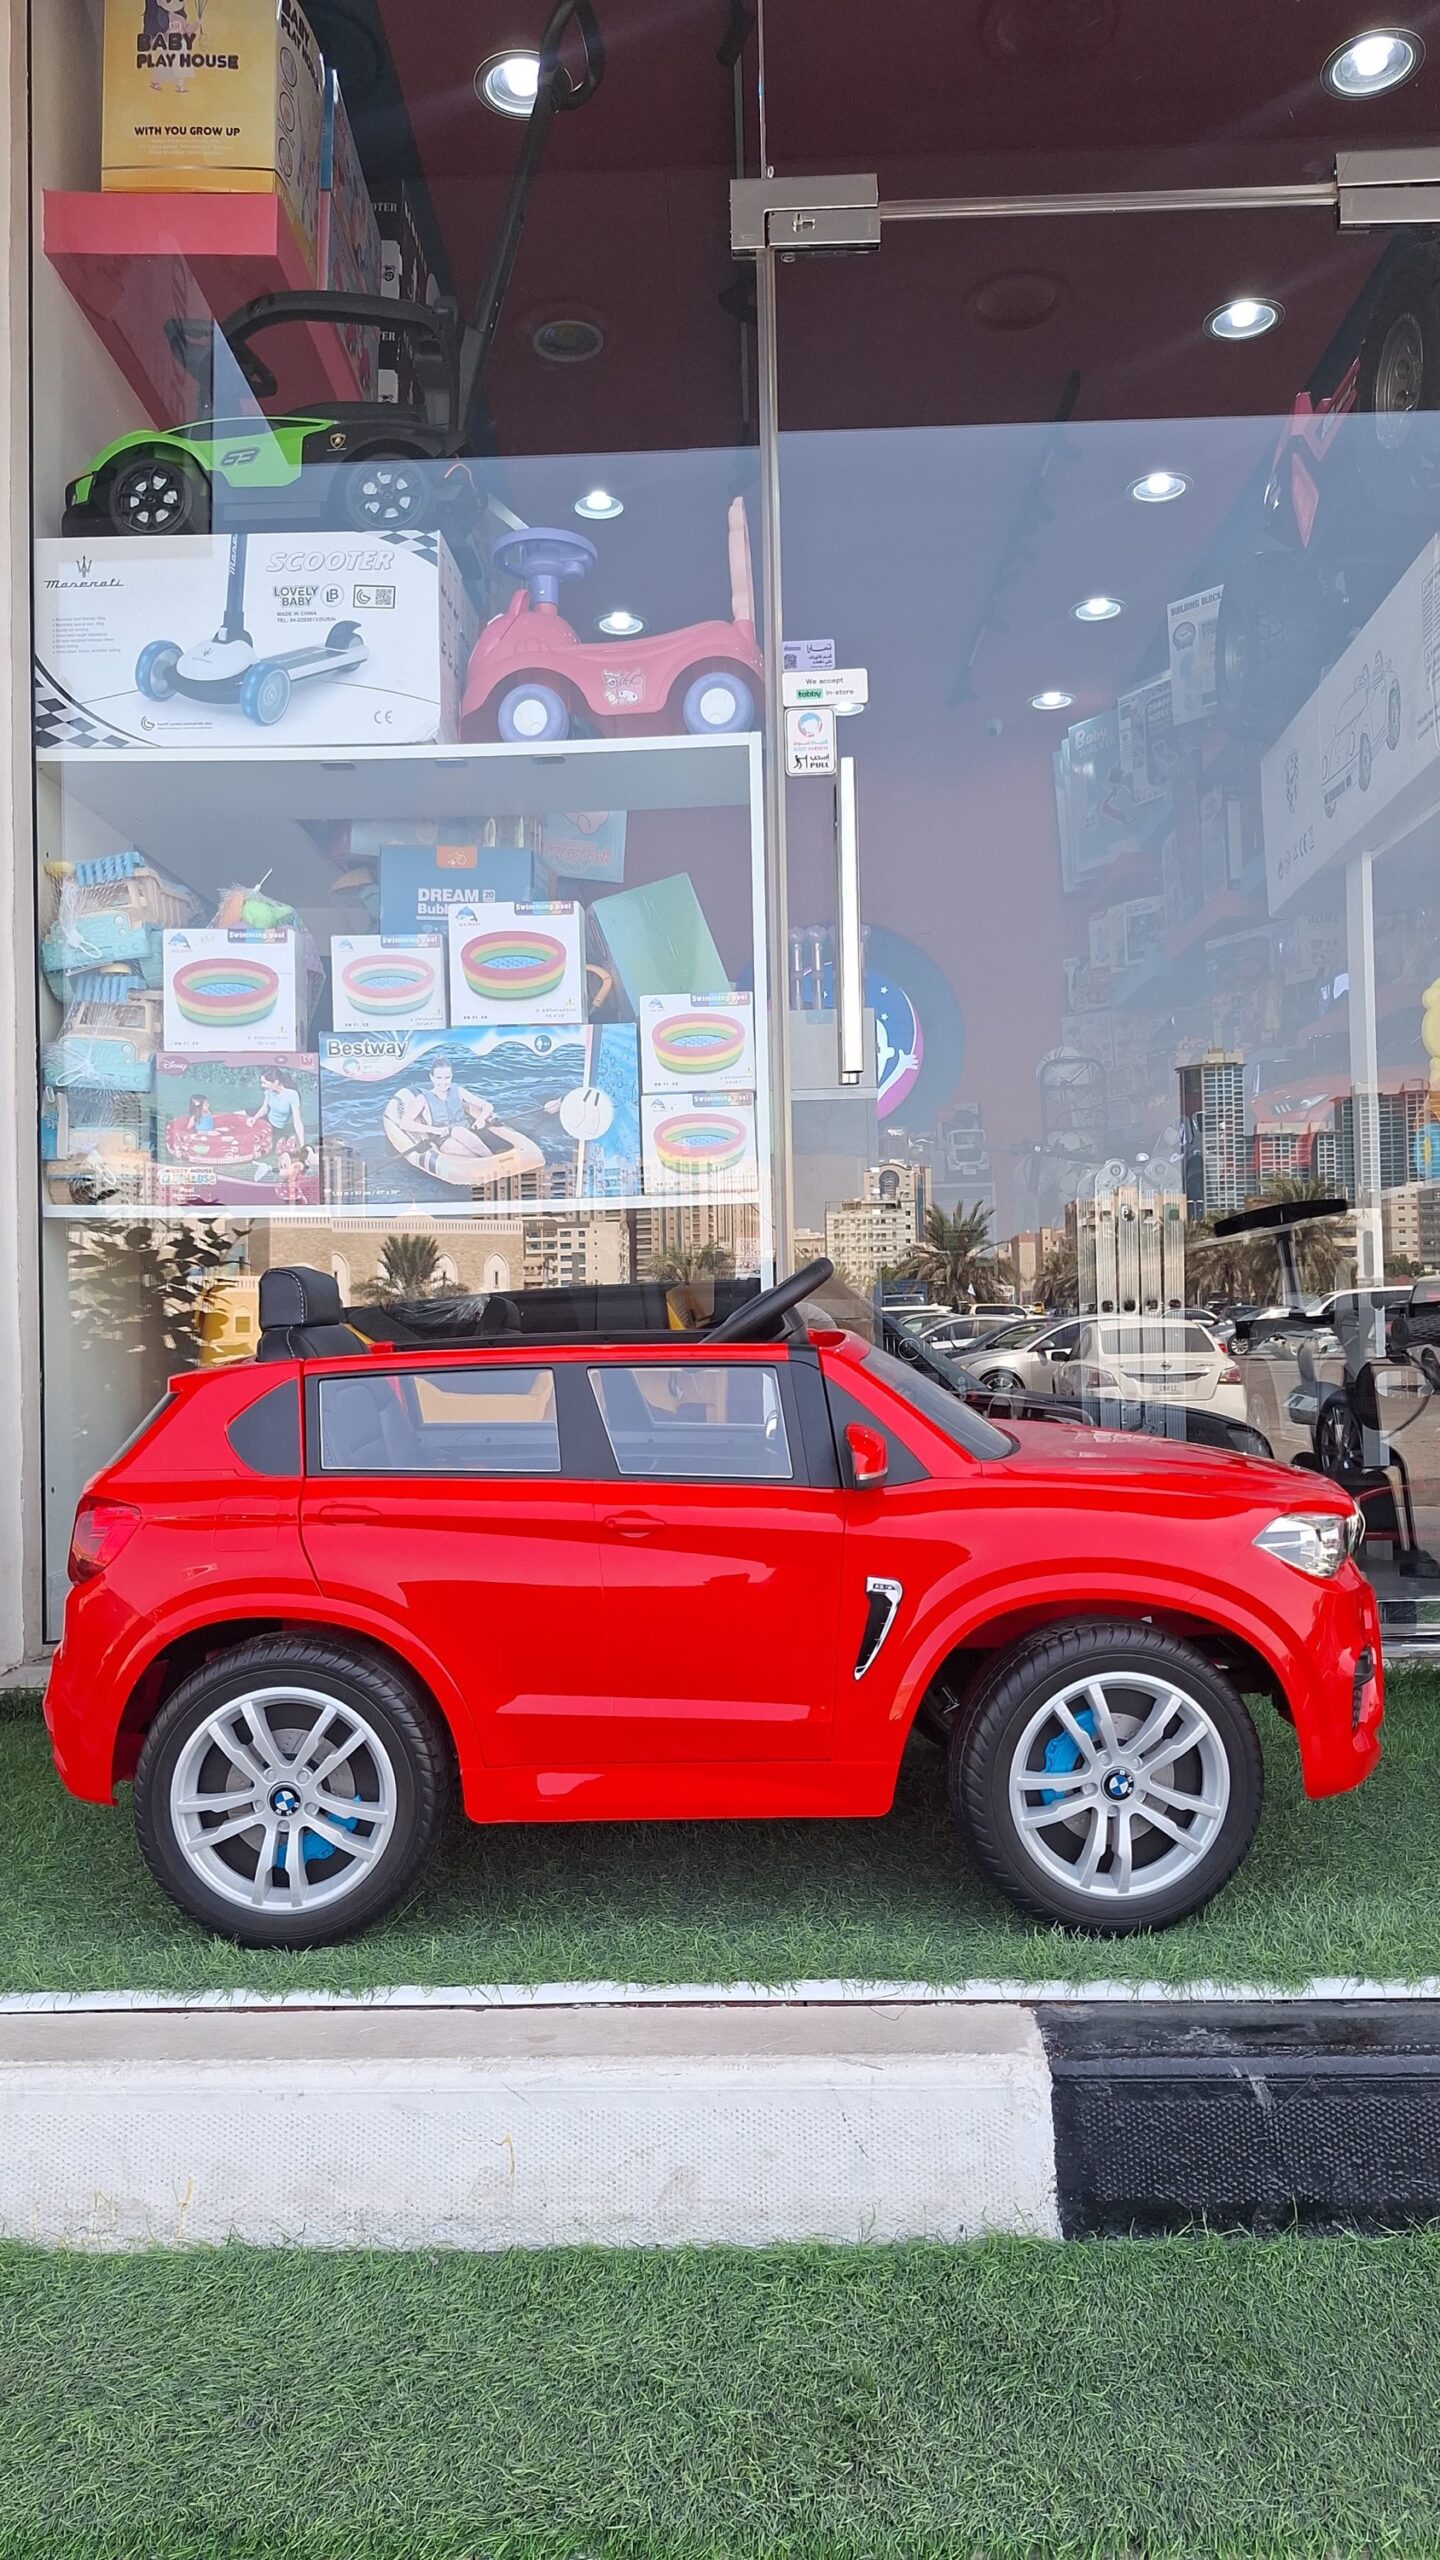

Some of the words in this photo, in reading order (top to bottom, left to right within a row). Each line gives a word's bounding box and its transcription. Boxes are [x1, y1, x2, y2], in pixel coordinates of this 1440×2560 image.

[136, 32, 197, 52] BABY
[136, 54, 176, 69] PLAY
[180, 54, 240, 70] HOUSE
[134, 126, 162, 136] WITH
[164, 126, 188, 136] YOU
[190, 126, 222, 136] GROW
[225, 127, 241, 137] UP
[265, 550, 395, 572] SCOOTER
[43, 578, 126, 588] Maserati
[274, 586, 318, 596] LOVELY
[282, 596, 312, 606] BABY
[418, 888, 479, 902] DREAM
[417, 903, 448, 914] Bub
[516, 903, 553, 912] Swimming
[555, 903, 572, 911] pool
[229, 931, 268, 940] Swimming
[269, 932, 285, 940] pool
[383, 936, 419, 944] Swimming
[422, 936, 438, 944] pool
[692, 994, 729, 1002] Swimming
[730, 994, 748, 1002] pool
[328, 1040, 408, 1058] Bestway
[163, 1060, 188, 1071] Disney
[694, 1095, 732, 1103] Swimming
